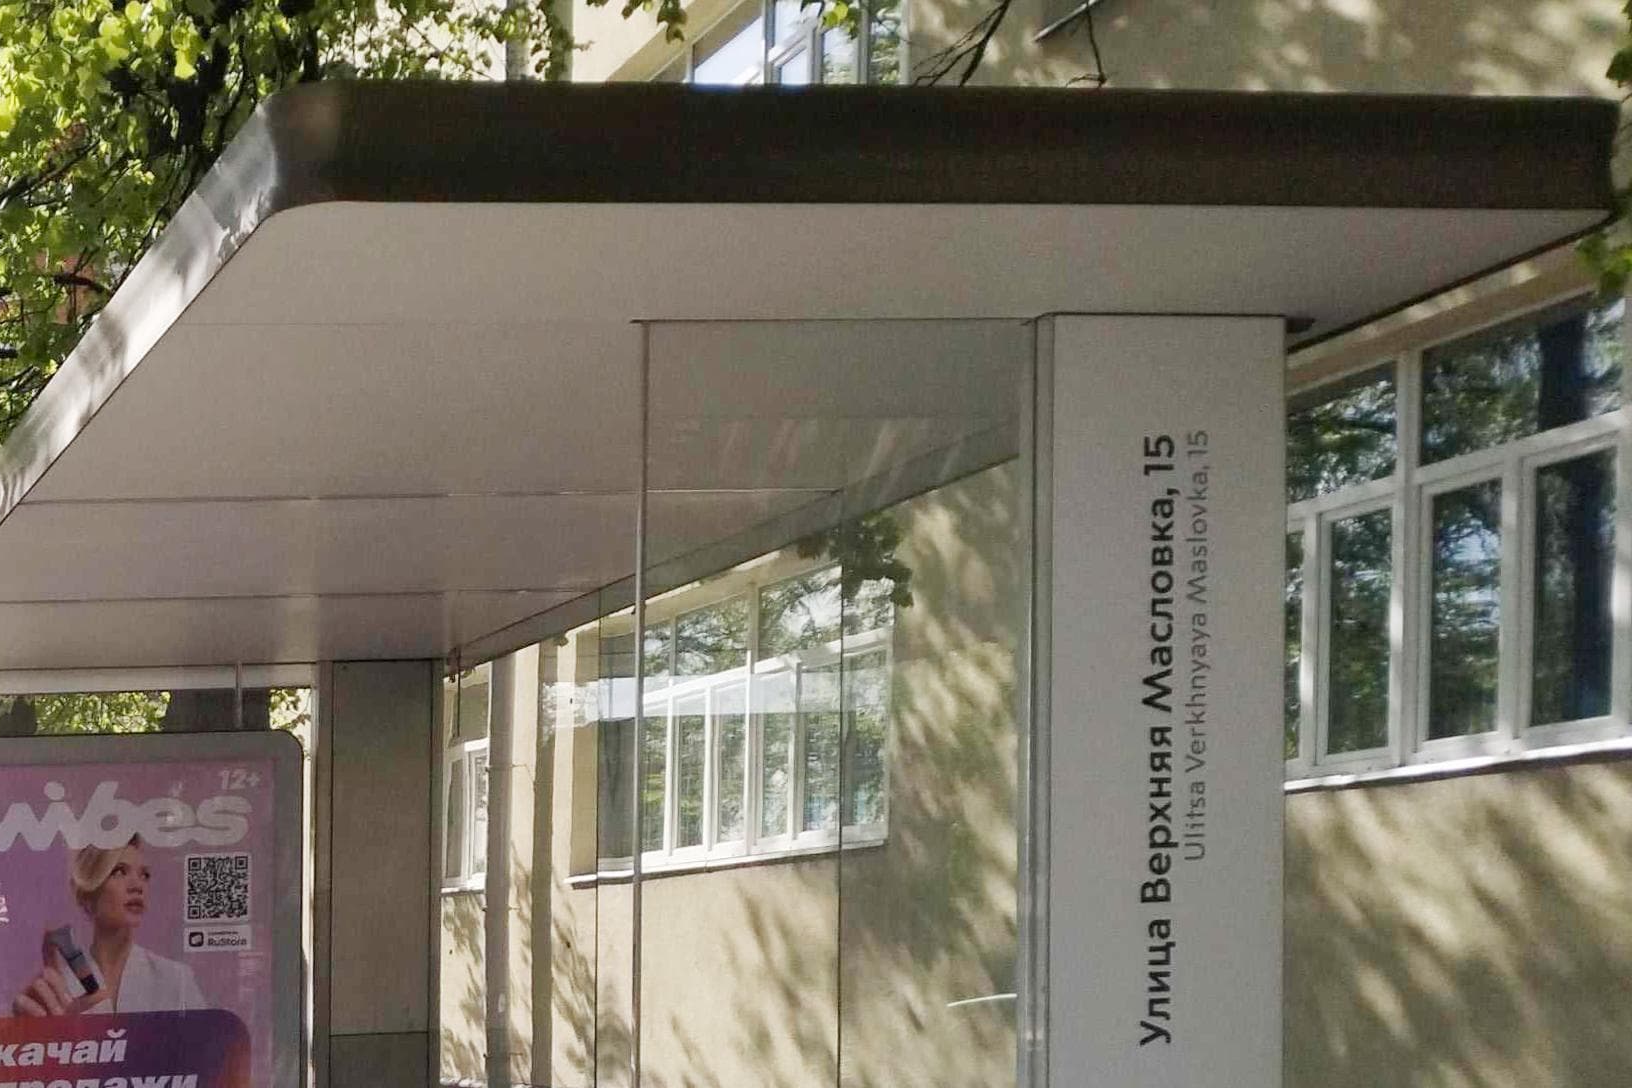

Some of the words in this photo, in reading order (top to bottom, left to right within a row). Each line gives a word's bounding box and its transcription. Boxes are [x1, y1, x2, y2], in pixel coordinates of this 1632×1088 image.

[1143, 434, 1175, 476] 15
[1186, 429, 1209, 457] 15
[1141, 488, 1180, 712] Масловка,
[1185, 465, 1211, 603] Maslovka,
[1183, 612, 1211, 774] Verkhnyaya
[1140, 726, 1178, 903] Верхняя
[1184, 780, 1206, 861] Ulitsa
[1140, 918, 1175, 1046] Улица
